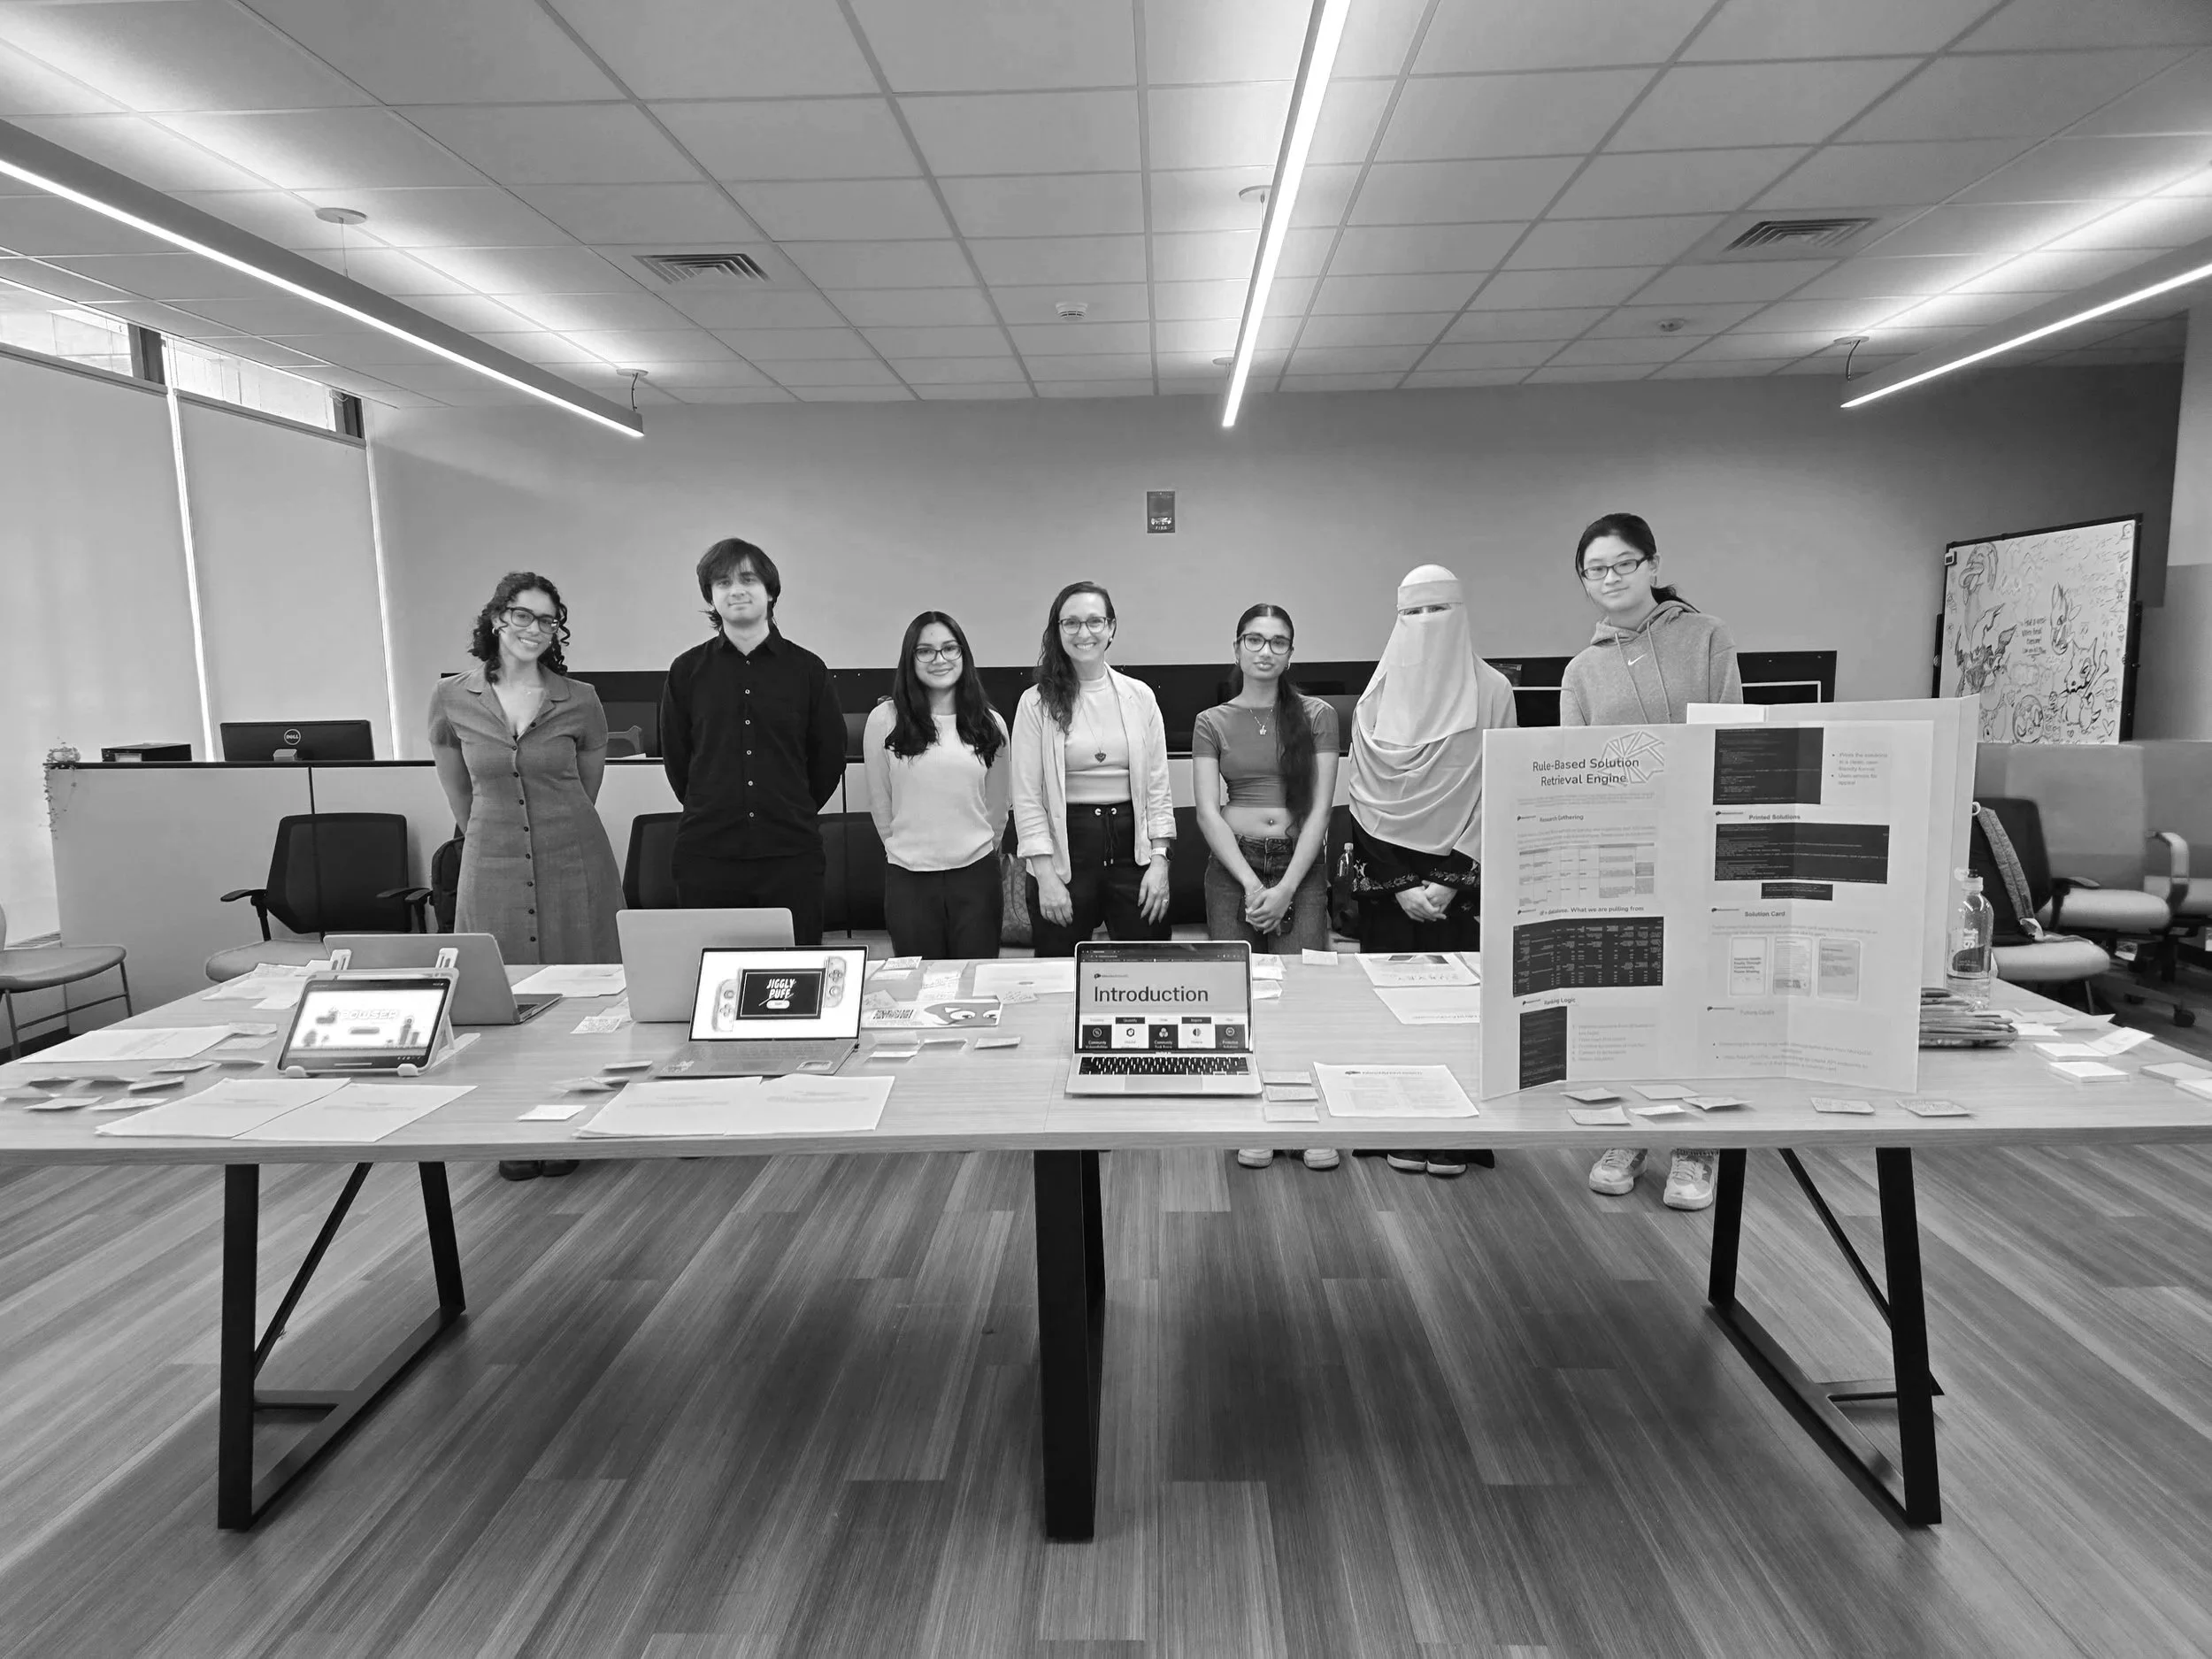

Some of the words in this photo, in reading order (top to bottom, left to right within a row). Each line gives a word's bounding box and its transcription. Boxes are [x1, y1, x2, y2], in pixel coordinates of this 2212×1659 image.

[1532, 758, 1586, 772] Rule-Based
[1590, 757, 1639, 769] Solution
[1541, 774, 1582, 786] Retrieval
[1586, 773, 1627, 786] Engine
[766, 979, 795, 989] JIGGLY
[769, 988, 790, 999] PUFF
[1094, 986, 1209, 1002] Introduction
